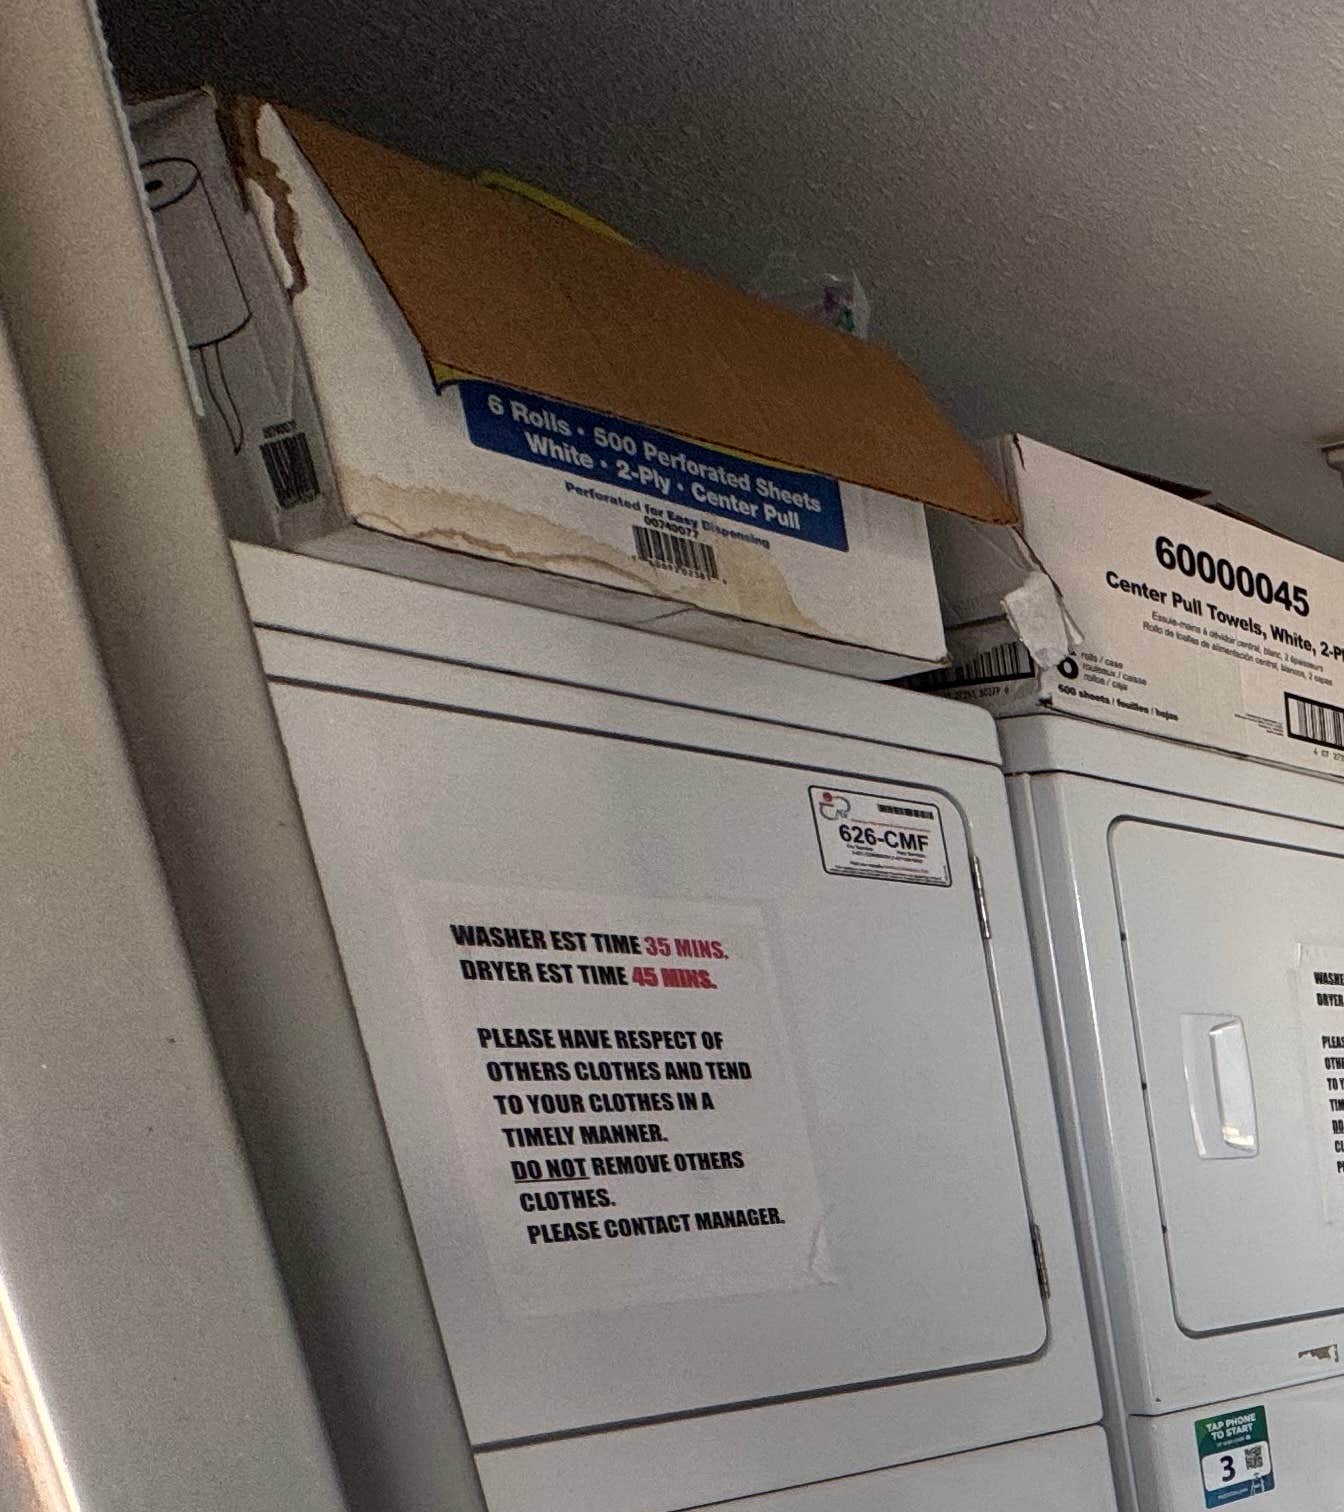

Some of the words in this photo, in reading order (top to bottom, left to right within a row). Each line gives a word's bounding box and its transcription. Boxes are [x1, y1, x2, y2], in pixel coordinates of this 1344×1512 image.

[488, 394, 504, 415] 6
[511, 400, 572, 436] Rolls
[594, 427, 637, 456] 500
[643, 441, 750, 490] Perforated
[756, 478, 821, 513] Sheets
[525, 431, 594, 470] White
[617, 460, 670, 495] 2-Ply
[691, 486, 758, 518] Center
[763, 504, 800, 530] Pull
[565, 480, 641, 511] Perforated
[644, 503, 663, 517] for
[666, 510, 698, 530] Easy
[701, 518, 770, 550] Dispensing
[1154, 535, 1311, 618] 60000045
[1105, 570, 1167, 608] Center
[1171, 592, 1203, 617] Pull
[1207, 603, 1268, 640] Towels,
[1270, 624, 1318, 657] White,
[838, 824, 929, 852] 626-CMF
[450, 924, 547, 951] WASHER
[551, 931, 588, 953] EST
[591, 933, 641, 955] TIME
[645, 936, 671, 958] 35
[674, 937, 729, 961] MINS.
[459, 959, 533, 983] DRYER
[536, 963, 573, 985] EST
[577, 965, 629, 986] TIME
[632, 966, 658, 988] 45
[660, 968, 717, 990] MINS.
[477, 1027, 555, 1050] PLEASE
[558, 1029, 611, 1049] HAVE
[615, 1030, 697, 1051] RESPECT
[701, 1031, 724, 1051] OF
[486, 1061, 571, 1082] OTHERS
[574, 1061, 661, 1082] CLOTHES
[665, 1061, 702, 1081] AND
[704, 1061, 752, 1081] TEND
[494, 1094, 524, 1116] TO
[526, 1093, 585, 1115] YOUR
[588, 1092, 675, 1113] CLOTHES
[677, 1091, 698, 1111] IN
[701, 1091, 715, 1111] A
[502, 1126, 579, 1149] TIMELY
[581, 1124, 668, 1146] MANNER.
[510, 1160, 543, 1181] DO
[547, 1157, 589, 1179] NOT
[591, 1154, 671, 1177] REMOVE
[673, 1151, 745, 1172] OTHERS
[519, 1188, 616, 1213] CLOTHES.
[527, 1220, 602, 1245] PLEASE
[604, 1213, 694, 1239] CONTACT
[695, 1207, 785, 1232] MANAGER.
[1206, 1421, 1224, 1432] TAP
[1226, 1413, 1256, 1427] PHONE
[1211, 1431, 1224, 1440] TO
[1226, 1423, 1253, 1437] START
[1220, 1455, 1236, 1482] 3
